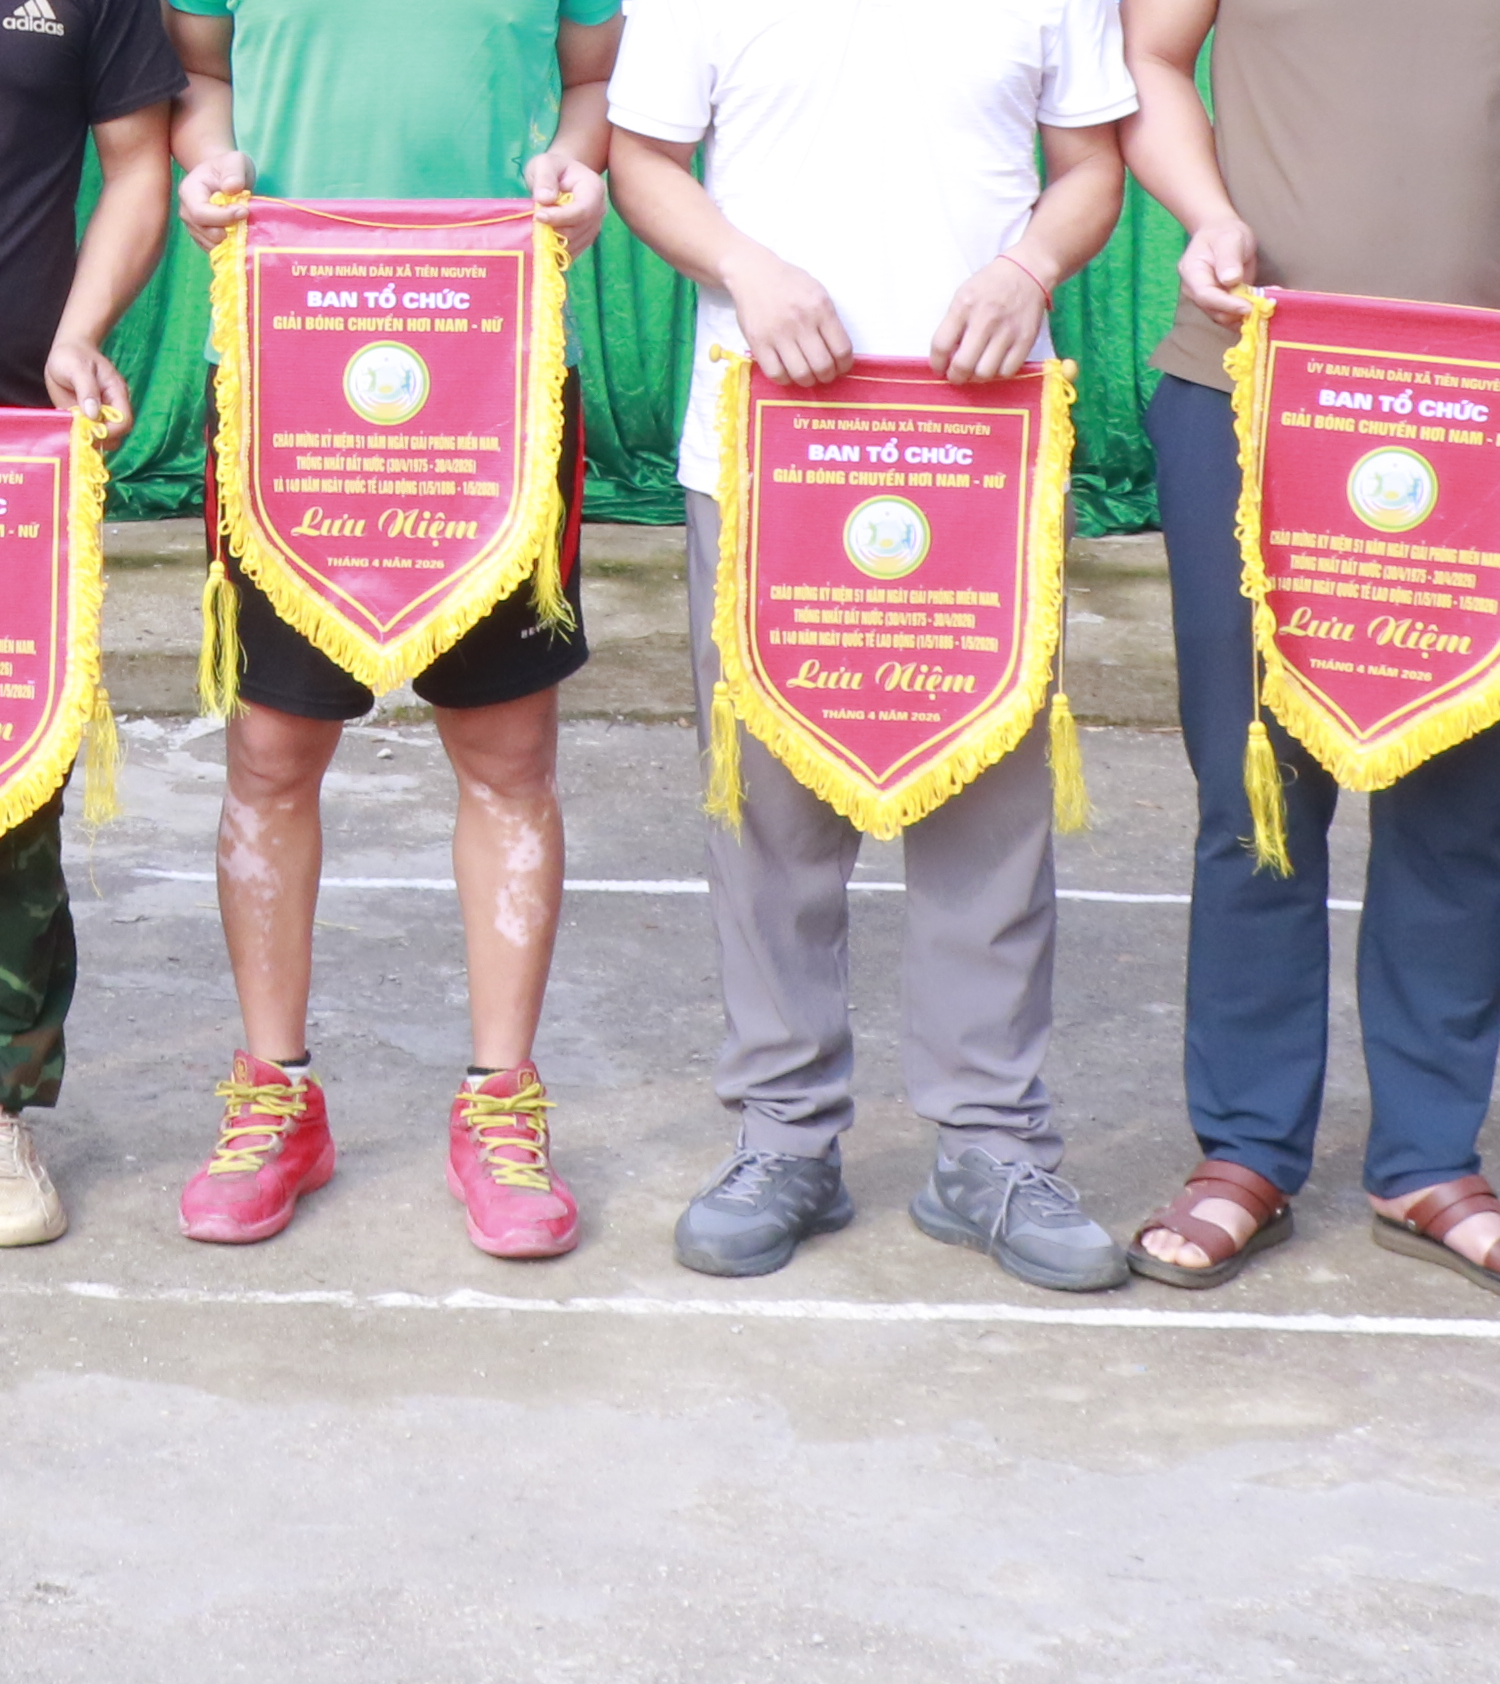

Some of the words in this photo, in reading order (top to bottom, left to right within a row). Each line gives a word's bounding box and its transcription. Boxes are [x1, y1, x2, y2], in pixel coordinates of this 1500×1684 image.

[2, 16, 65, 36] adidas
[307, 291, 358, 308] BAN
[363, 283, 397, 309] TỔ
[402, 288, 470, 309] CHỨC
[273, 311, 302, 330] GIẢI
[305, 314, 344, 331] BÓNG
[407, 317, 431, 332] HƠI
[434, 318, 468, 332] NAM
[1319, 389, 1373, 410] BAN
[1378, 389, 1413, 414] TỔ
[1418, 399, 1489, 422] CHỨC
[808, 444, 860, 462] BAN
[866, 437, 899, 463] TỔ
[904, 444, 973, 465] CHỨC
[291, 506, 366, 537] Lưu
[378, 508, 480, 547] Niệm
[327, 556, 369, 567] THÁNG
[372, 559, 380, 567] 4
[382, 556, 412, 568] NĂM
[415, 559, 445, 569] 2026
[1279, 606, 1355, 642] Lưu
[1367, 616, 1472, 659] Niệm
[786, 659, 863, 690] Lưu
[875, 661, 977, 700] Niệm
[1311, 658, 1354, 672] THÁNG
[1357, 664, 1365, 673] 4
[1368, 664, 1399, 677] NĂM
[1401, 669, 1432, 682] 2026
[822, 708, 865, 720] THÁNG
[867, 711, 876, 720] 4
[878, 709, 909, 721] NĂM
[911, 712, 941, 722] 2026
